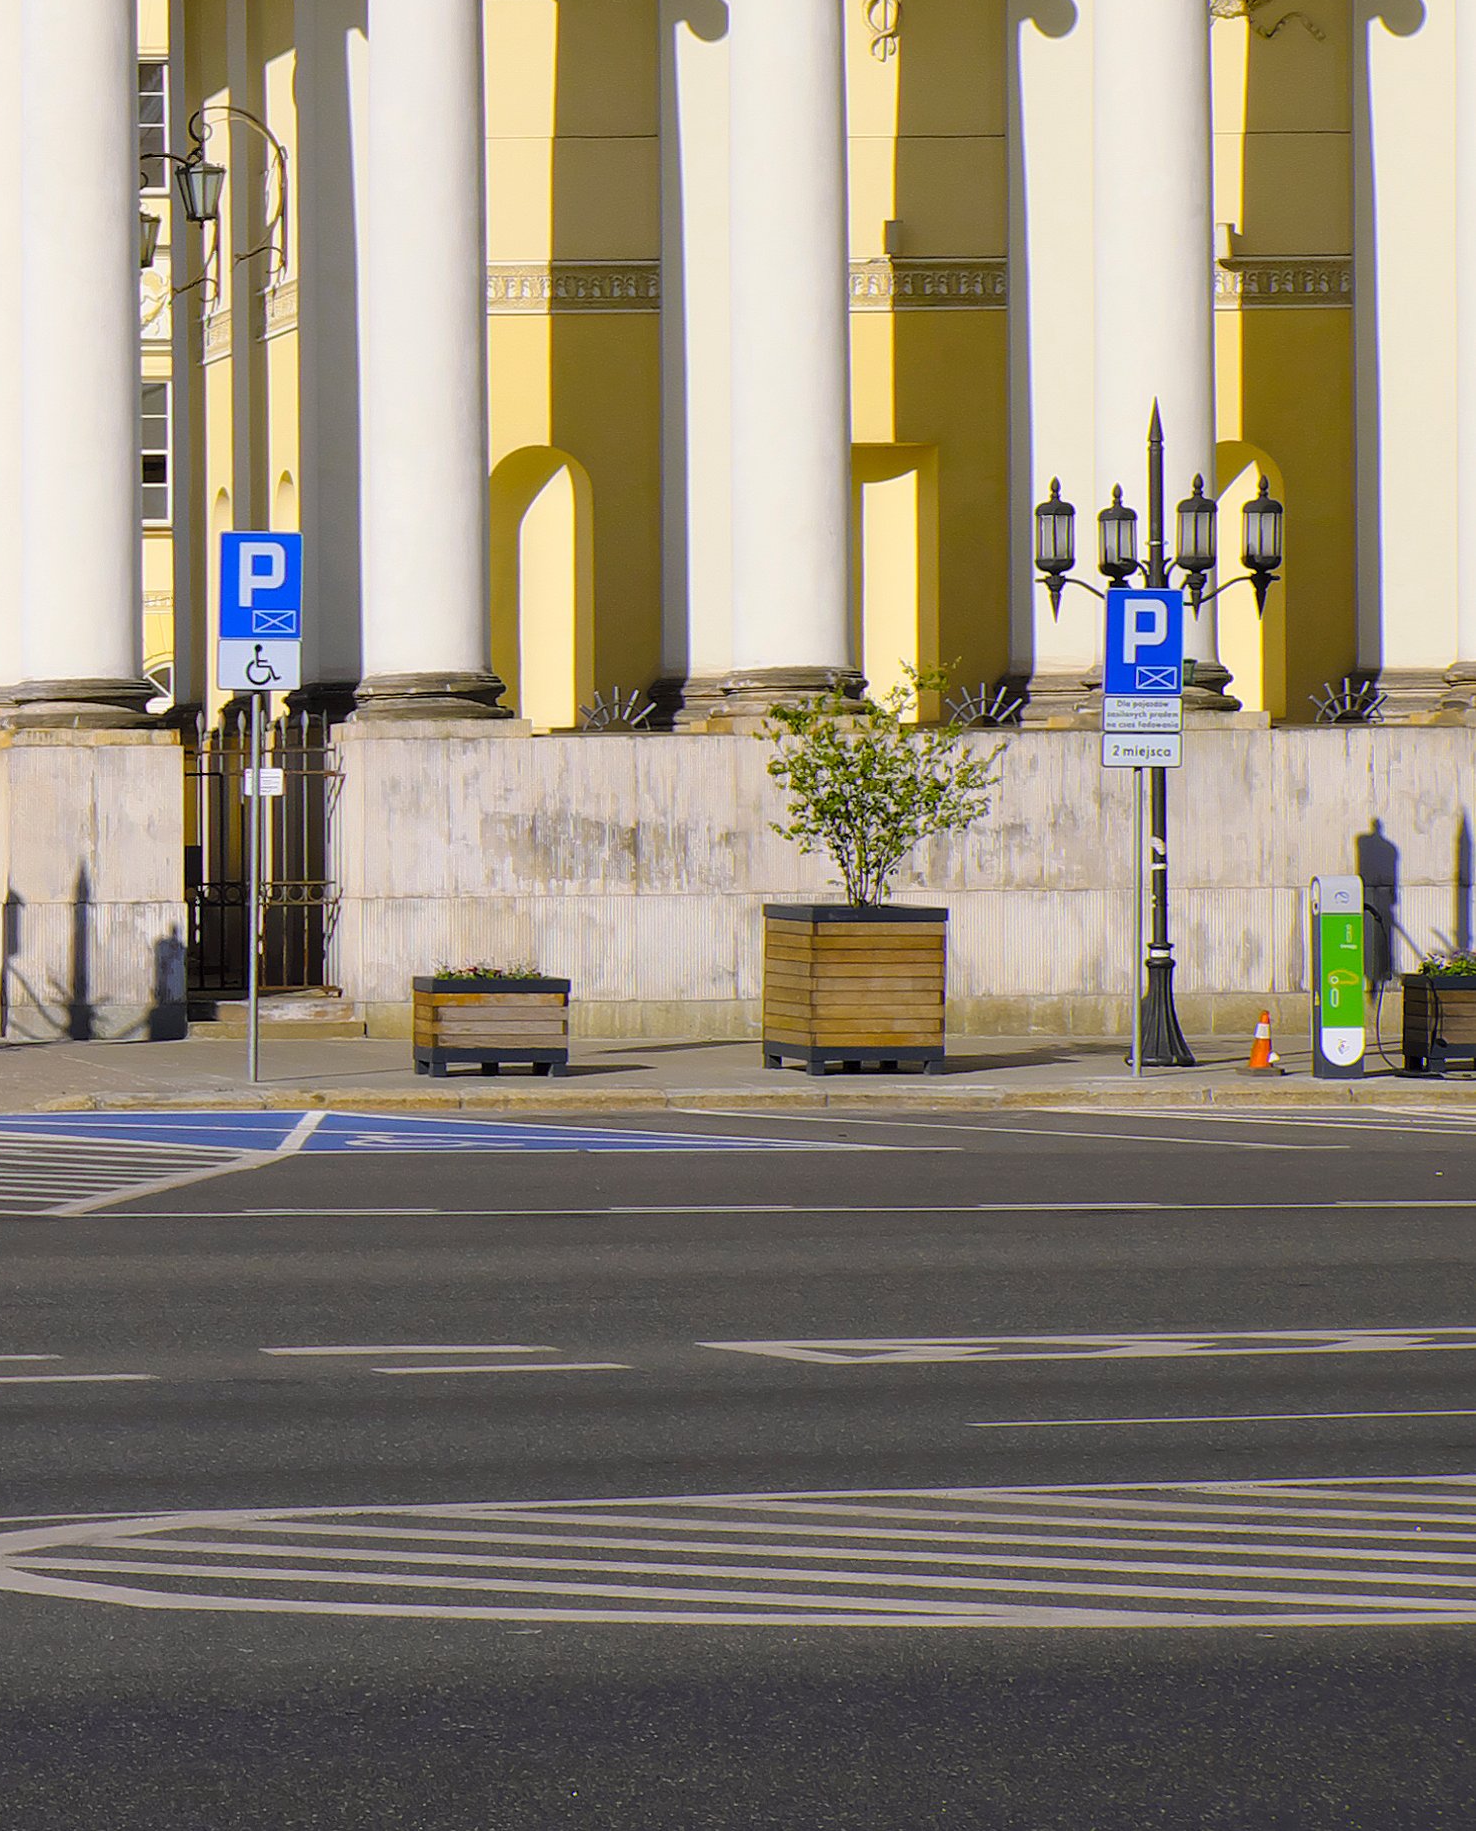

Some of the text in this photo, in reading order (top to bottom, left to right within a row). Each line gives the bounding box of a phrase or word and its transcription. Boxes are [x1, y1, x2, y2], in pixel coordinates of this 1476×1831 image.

[238, 541, 286, 607] P
[1122, 598, 1168, 664] P
[1112, 745, 1171, 759] 2 miejsca
